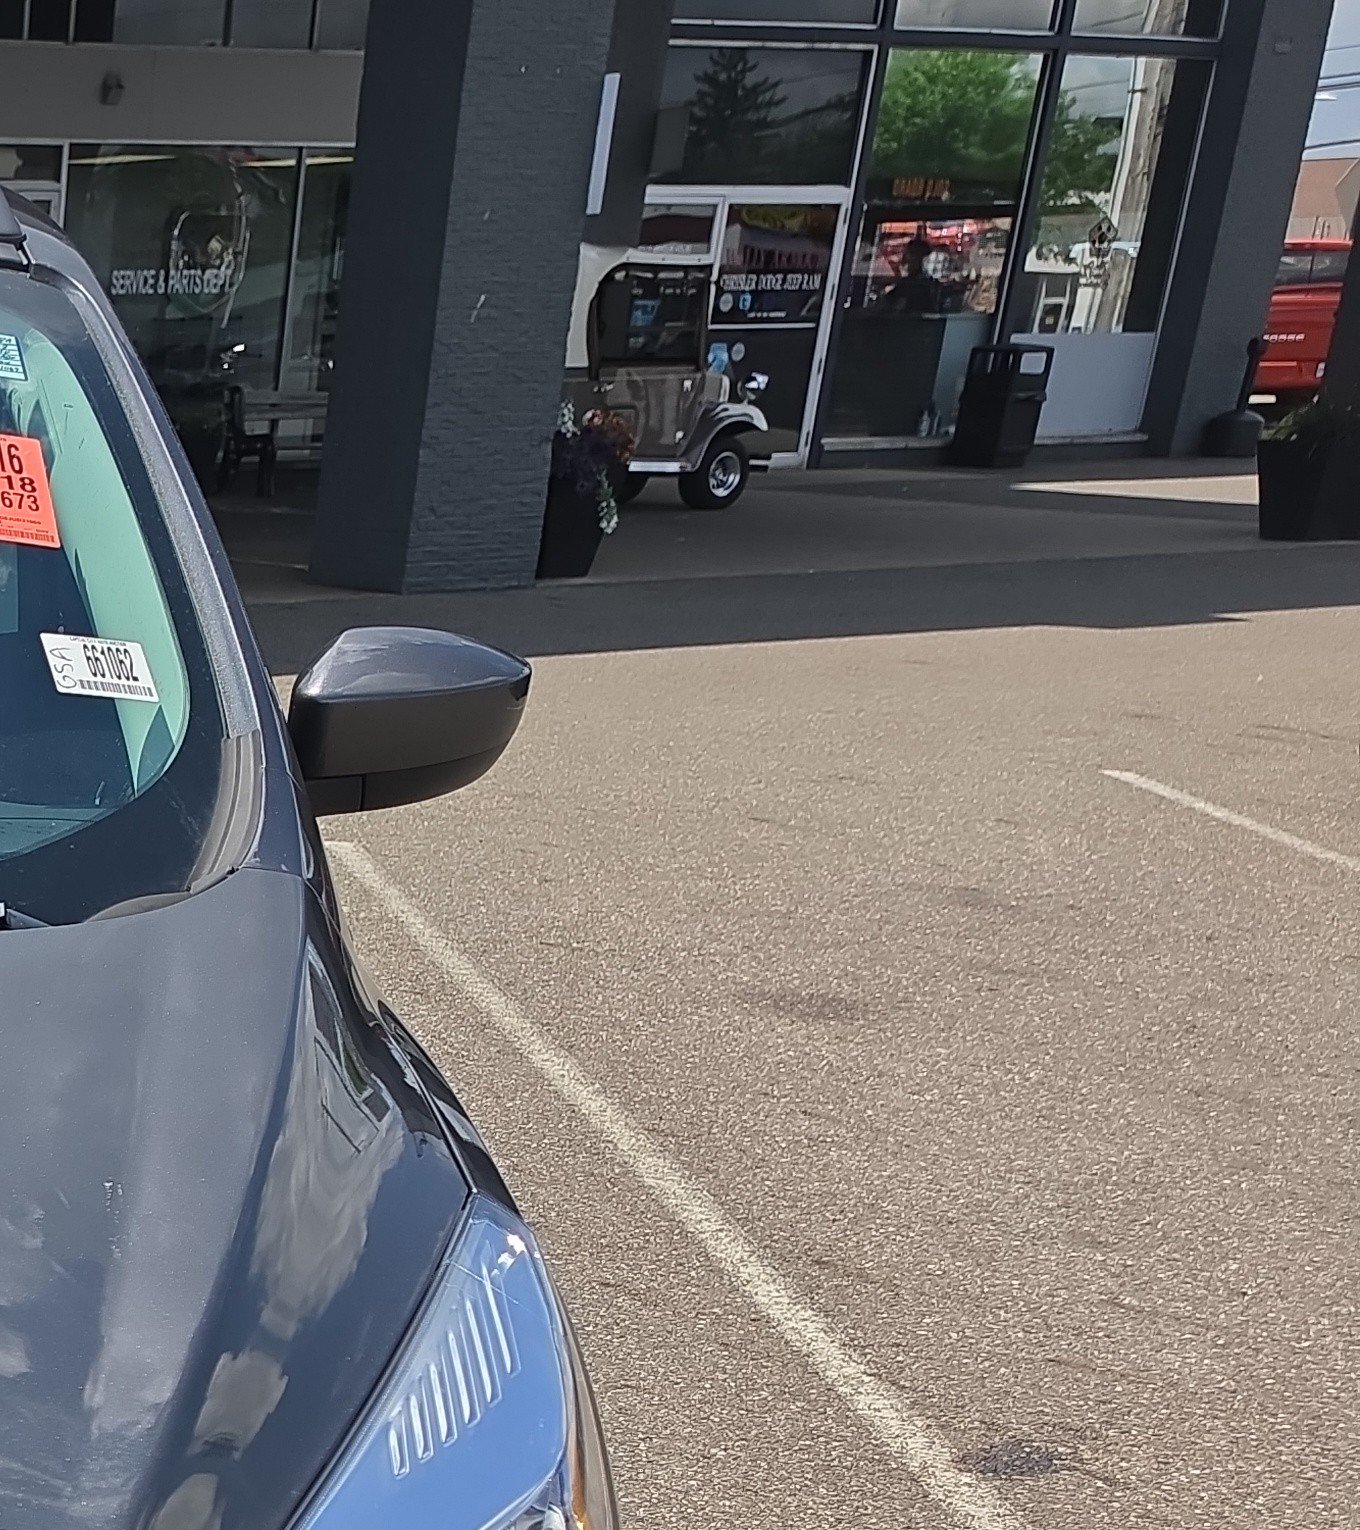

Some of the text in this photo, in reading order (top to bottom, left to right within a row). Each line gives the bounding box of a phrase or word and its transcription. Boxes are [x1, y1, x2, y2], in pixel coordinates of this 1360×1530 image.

[110, 269, 157, 295] SERVICE
[156, 269, 166, 295] &
[167, 268, 202, 295] PARTS
[82, 643, 140, 682] 661062
